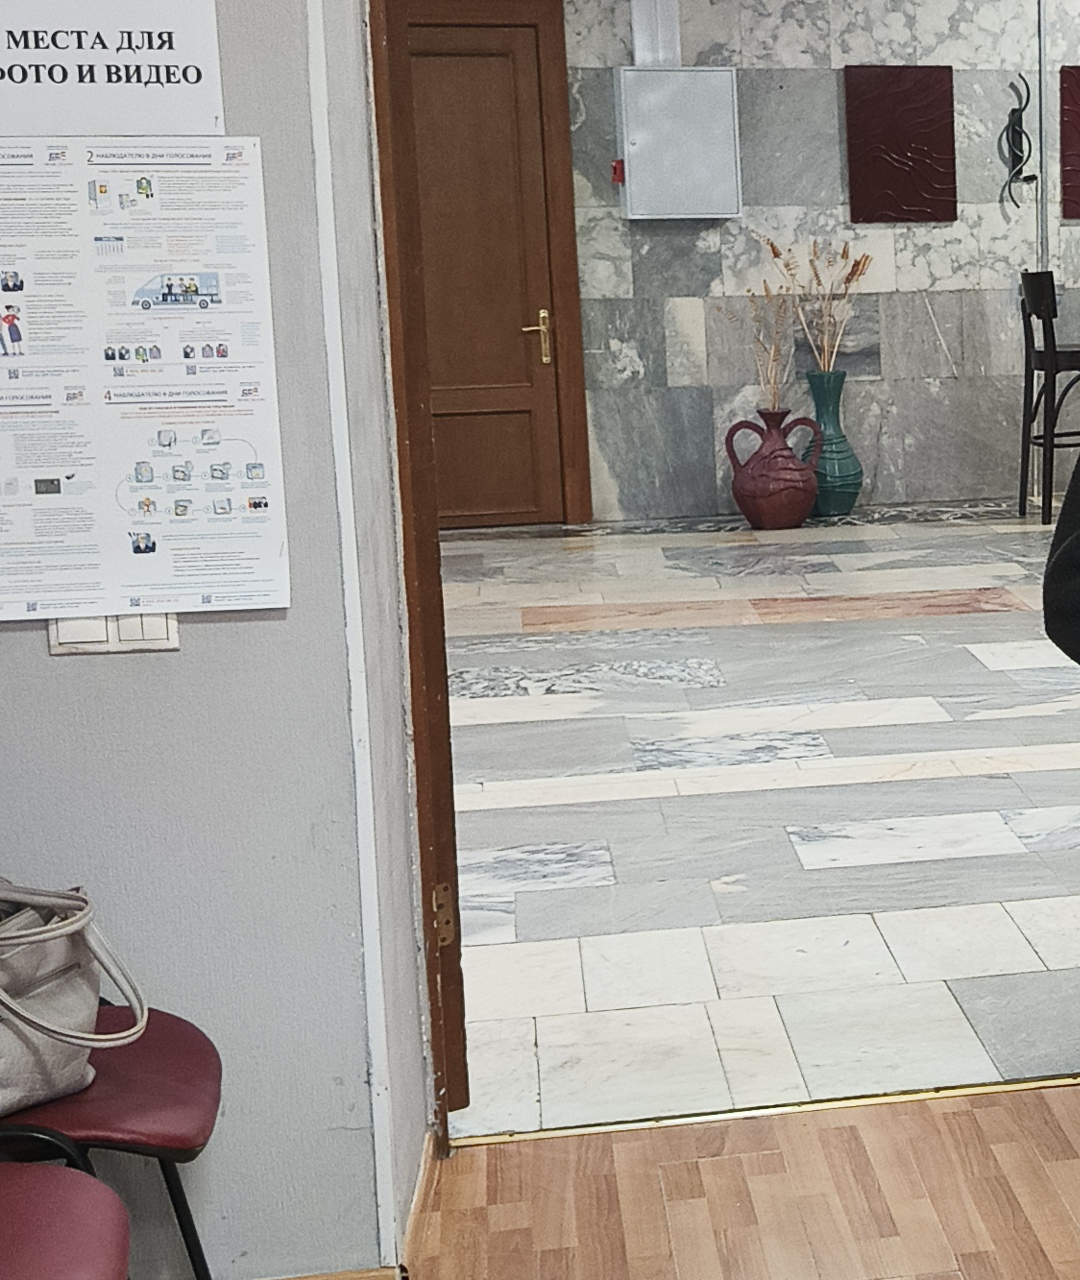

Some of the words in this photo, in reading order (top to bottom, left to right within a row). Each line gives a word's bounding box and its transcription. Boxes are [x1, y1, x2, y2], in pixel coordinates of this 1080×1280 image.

[6, 30, 109, 50] МЕСТА
[116, 30, 175, 54] ДЛЯ
[76, 64, 97, 84] И
[105, 64, 203, 88] ВИДЕО
[86, 150, 94, 162] 2
[104, 390, 112, 401] 4
